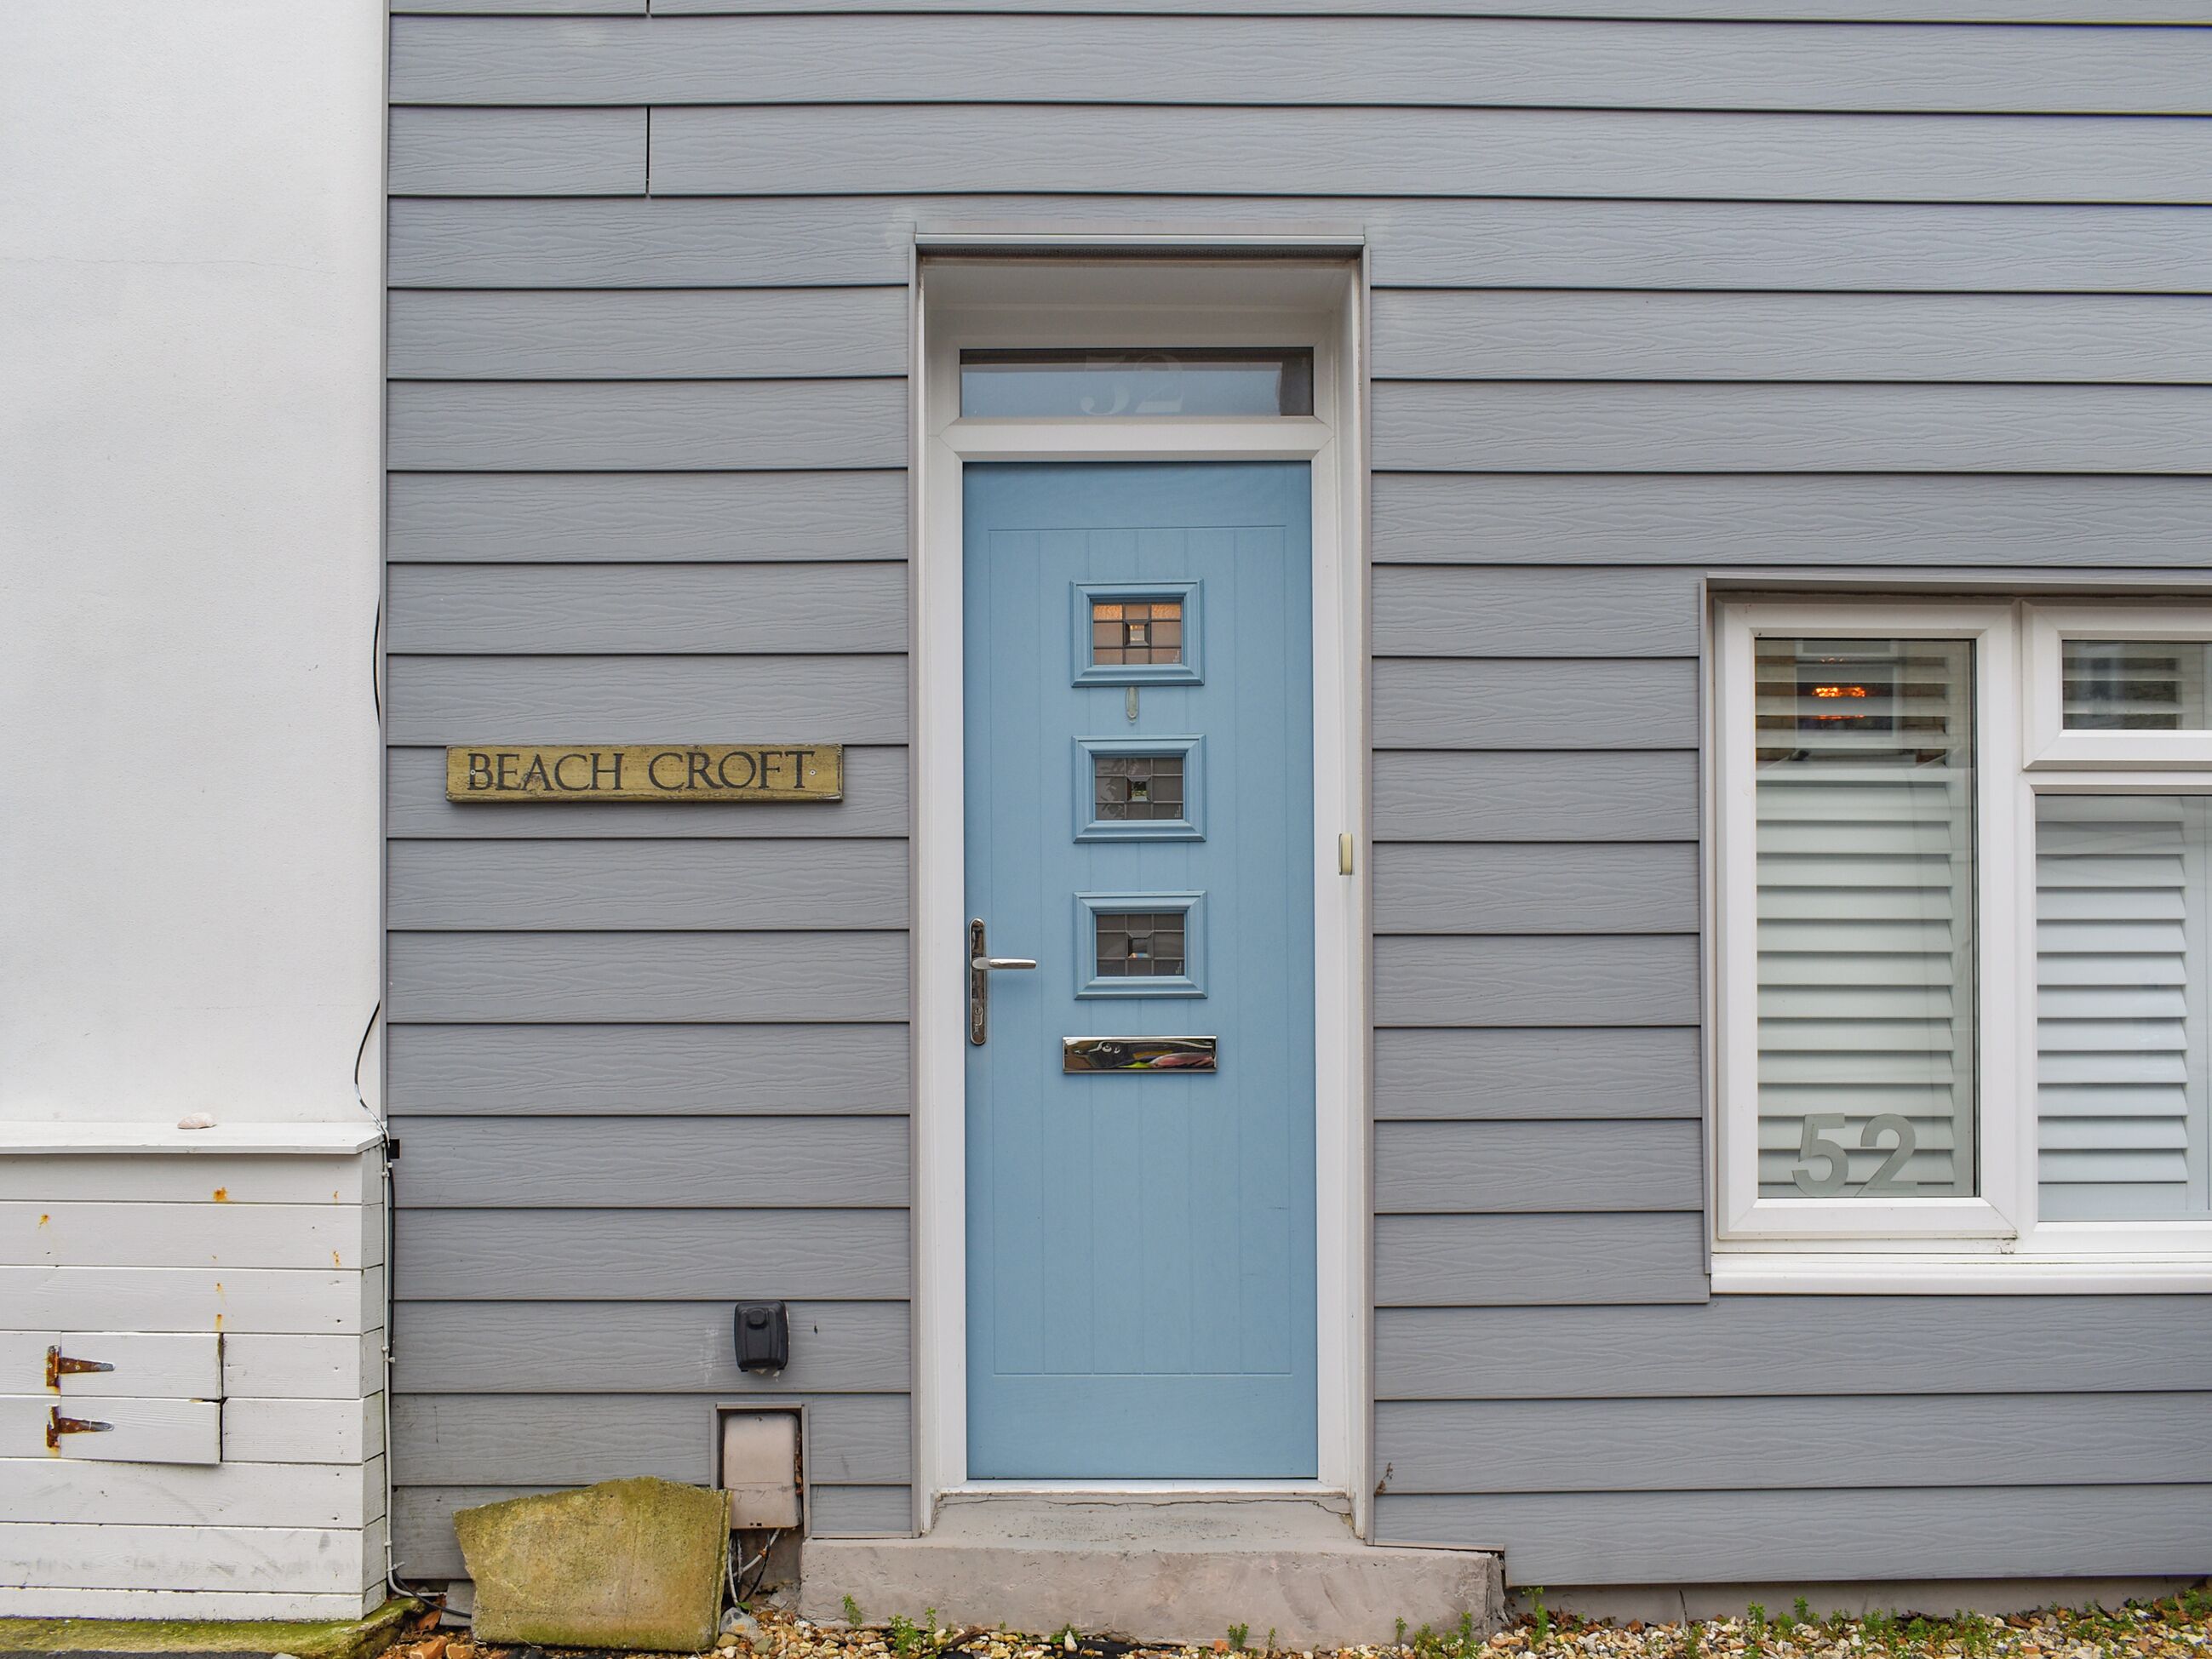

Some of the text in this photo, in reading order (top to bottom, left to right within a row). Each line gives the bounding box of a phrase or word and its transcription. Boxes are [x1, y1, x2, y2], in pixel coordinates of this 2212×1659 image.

[1080, 353, 1184, 415] 52
[467, 750, 816, 792] BEACH CROFT
[1791, 1113, 1917, 1198] 52
